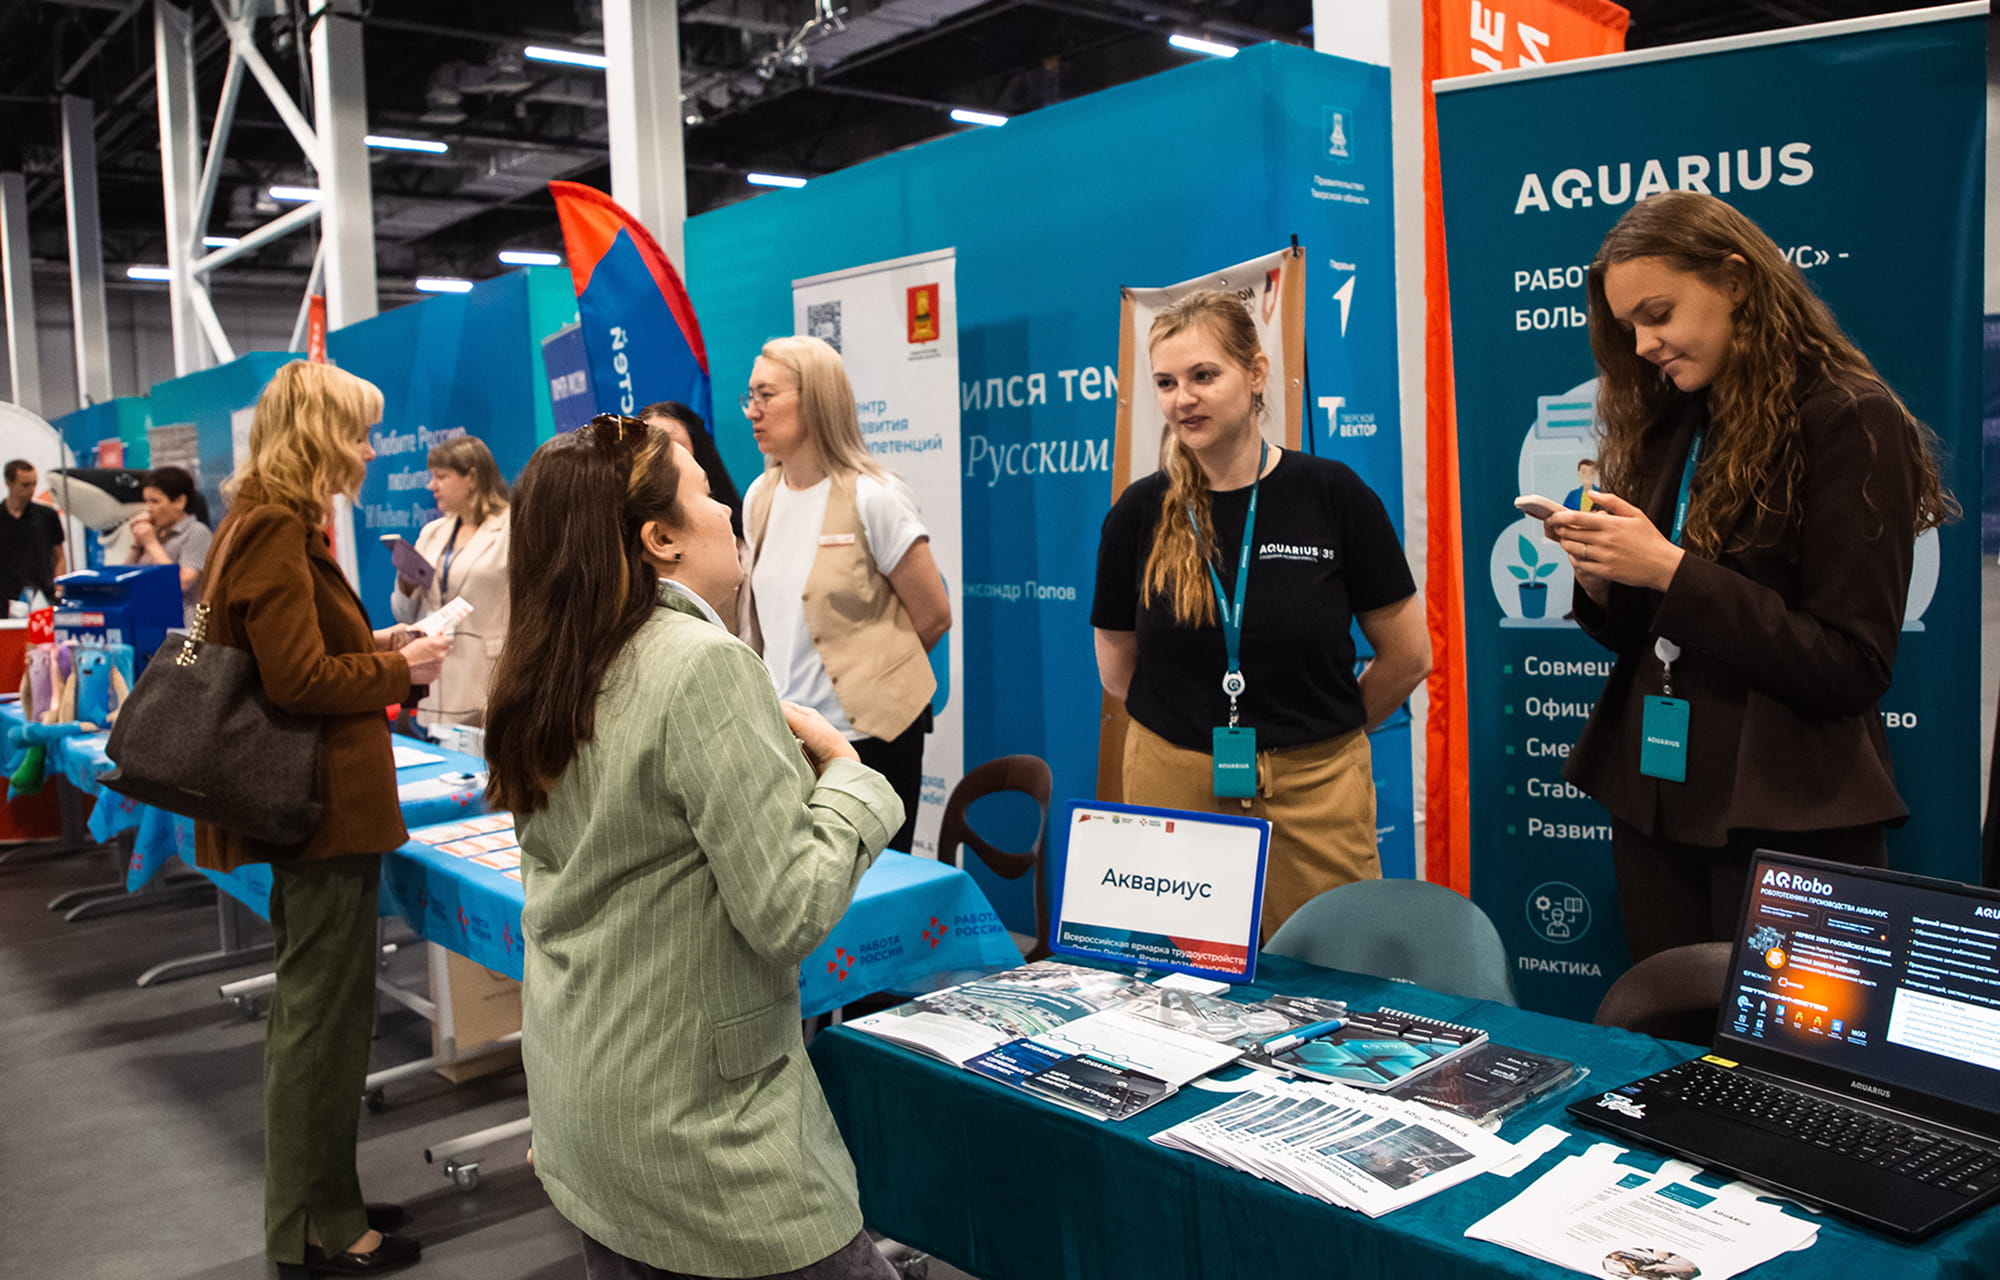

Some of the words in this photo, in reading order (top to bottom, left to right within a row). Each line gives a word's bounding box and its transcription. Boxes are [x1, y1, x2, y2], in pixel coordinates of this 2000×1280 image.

[1514, 142, 1814, 214] AQUARIUS
[1340, 423, 1377, 438] ВЕКТОР
[966, 438, 1109, 487] Русским
[1259, 543, 1319, 556] AQUARIUS
[1322, 548, 1335, 560] 35
[1025, 581, 1077, 600] Попов
[1526, 737, 1575, 758] Сме
[1100, 867, 1213, 901] Аквариус
[1064, 931, 1129, 948] Всероссийская
[1131, 942, 1170, 955] ярмарка
[1519, 957, 1602, 976] ПРАКТИКА
[1850, 1080, 1891, 1098] AQUARIUS
